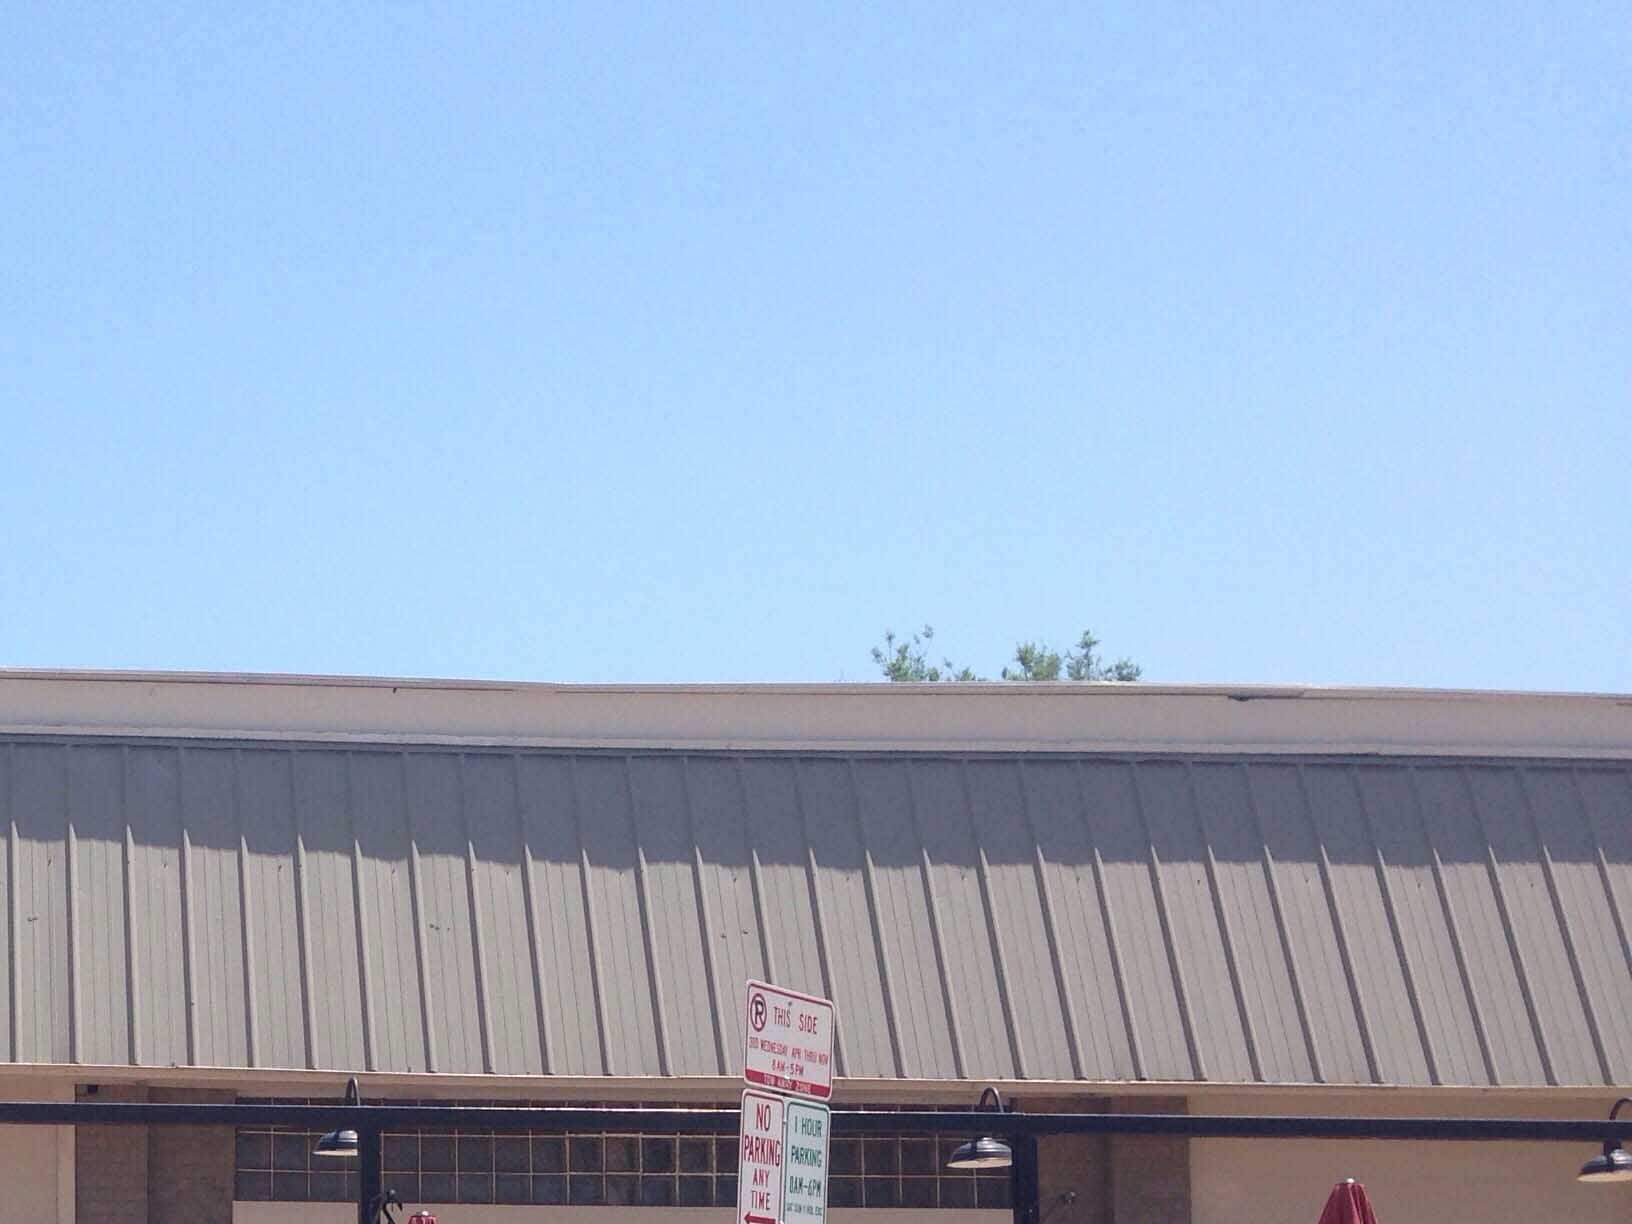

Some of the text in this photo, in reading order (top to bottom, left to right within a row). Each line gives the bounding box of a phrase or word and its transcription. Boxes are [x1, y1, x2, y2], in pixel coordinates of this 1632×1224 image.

[773, 1005, 818, 1036] THIS SIDE
[755, 1103, 772, 1133] NO
[801, 1118, 822, 1138] HOUR
[743, 1135, 781, 1167] PARKING
[790, 1146, 822, 1169] PARKING
[752, 1167, 770, 1187] ANY
[751, 1190, 771, 1211] TIME
